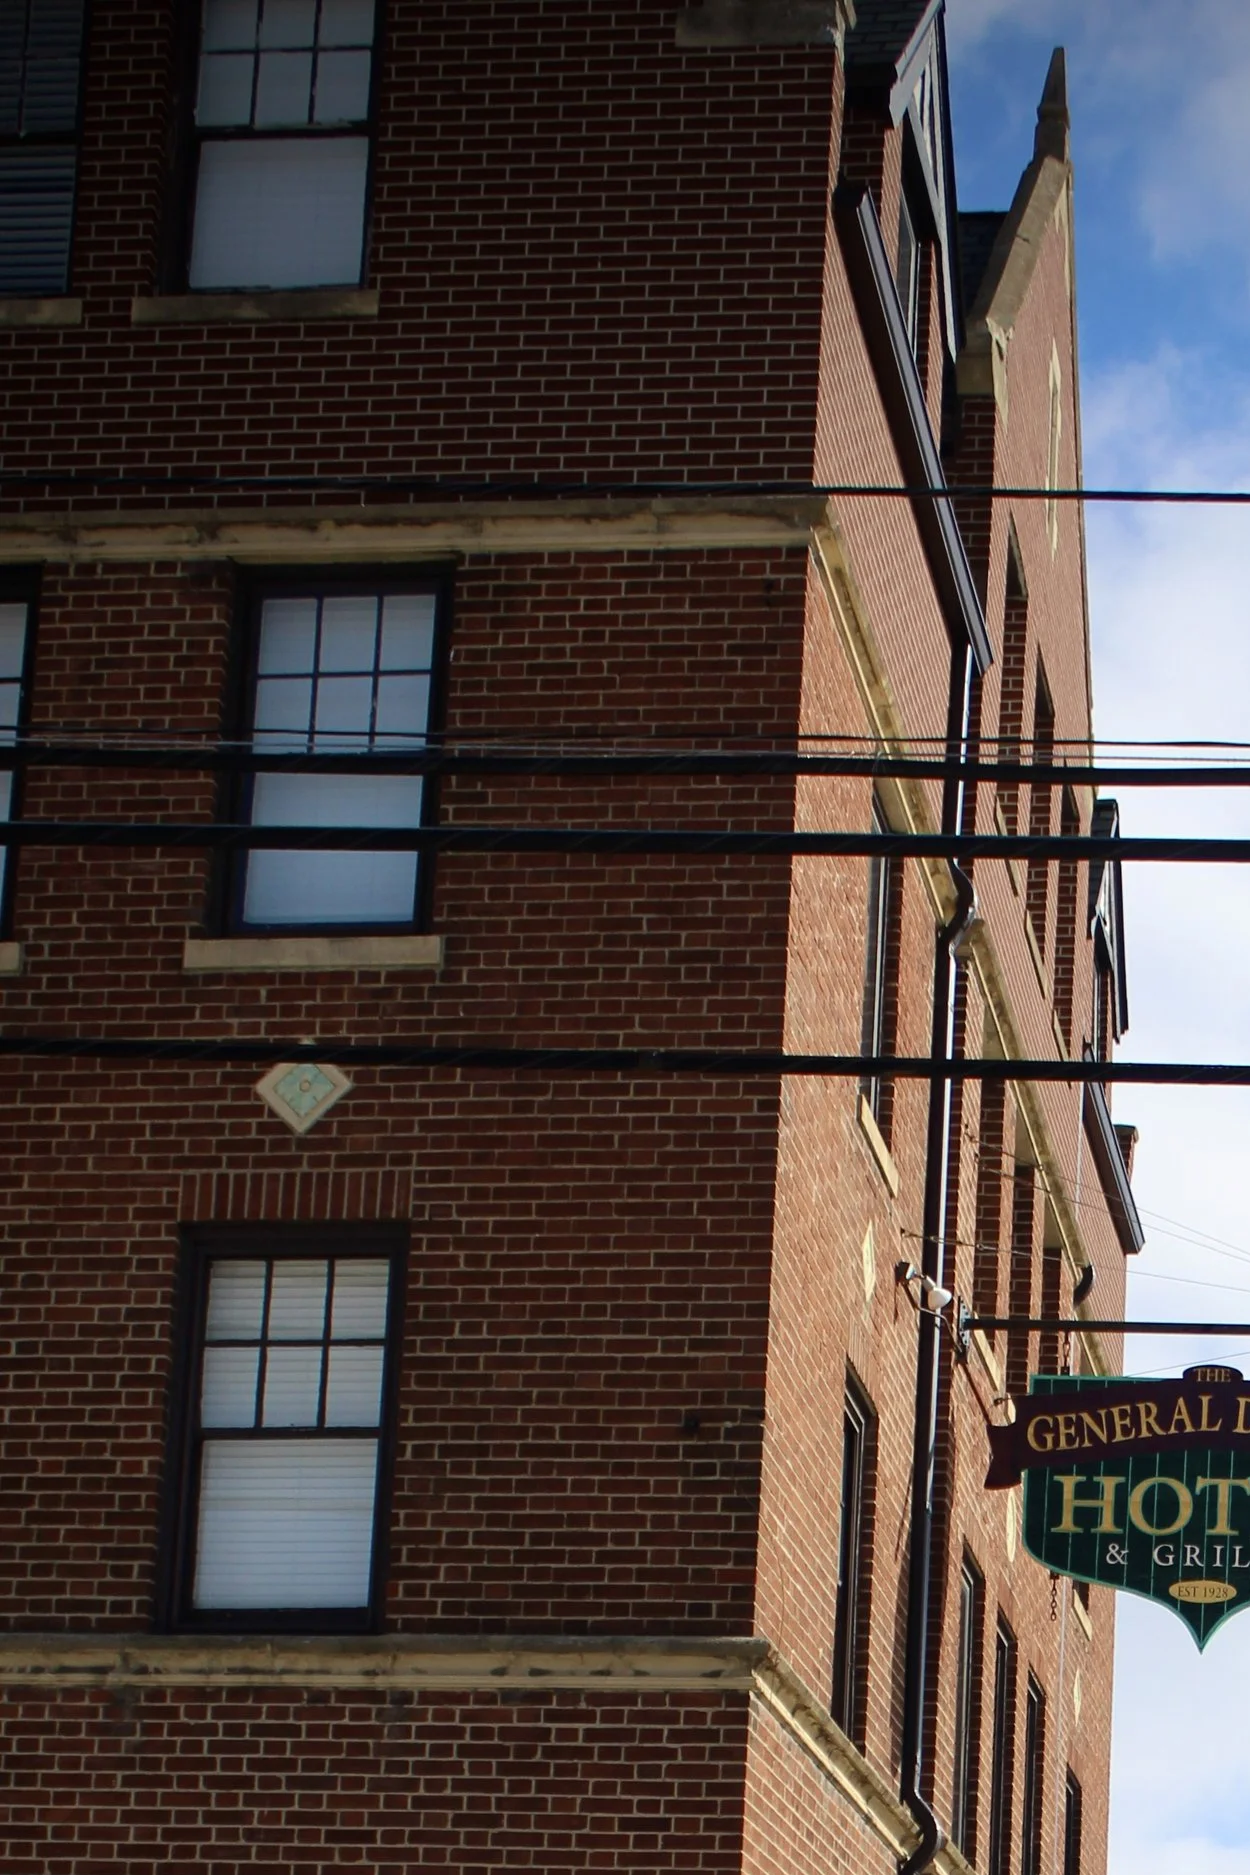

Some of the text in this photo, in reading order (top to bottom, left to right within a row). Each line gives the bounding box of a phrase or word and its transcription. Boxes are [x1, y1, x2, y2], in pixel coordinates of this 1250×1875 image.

[1194, 1368, 1231, 1383] THE
[1026, 1395, 1222, 1453] GENERAL
[1105, 1543, 1129, 1565] &
[1177, 1586, 1229, 1599] EST 1928
